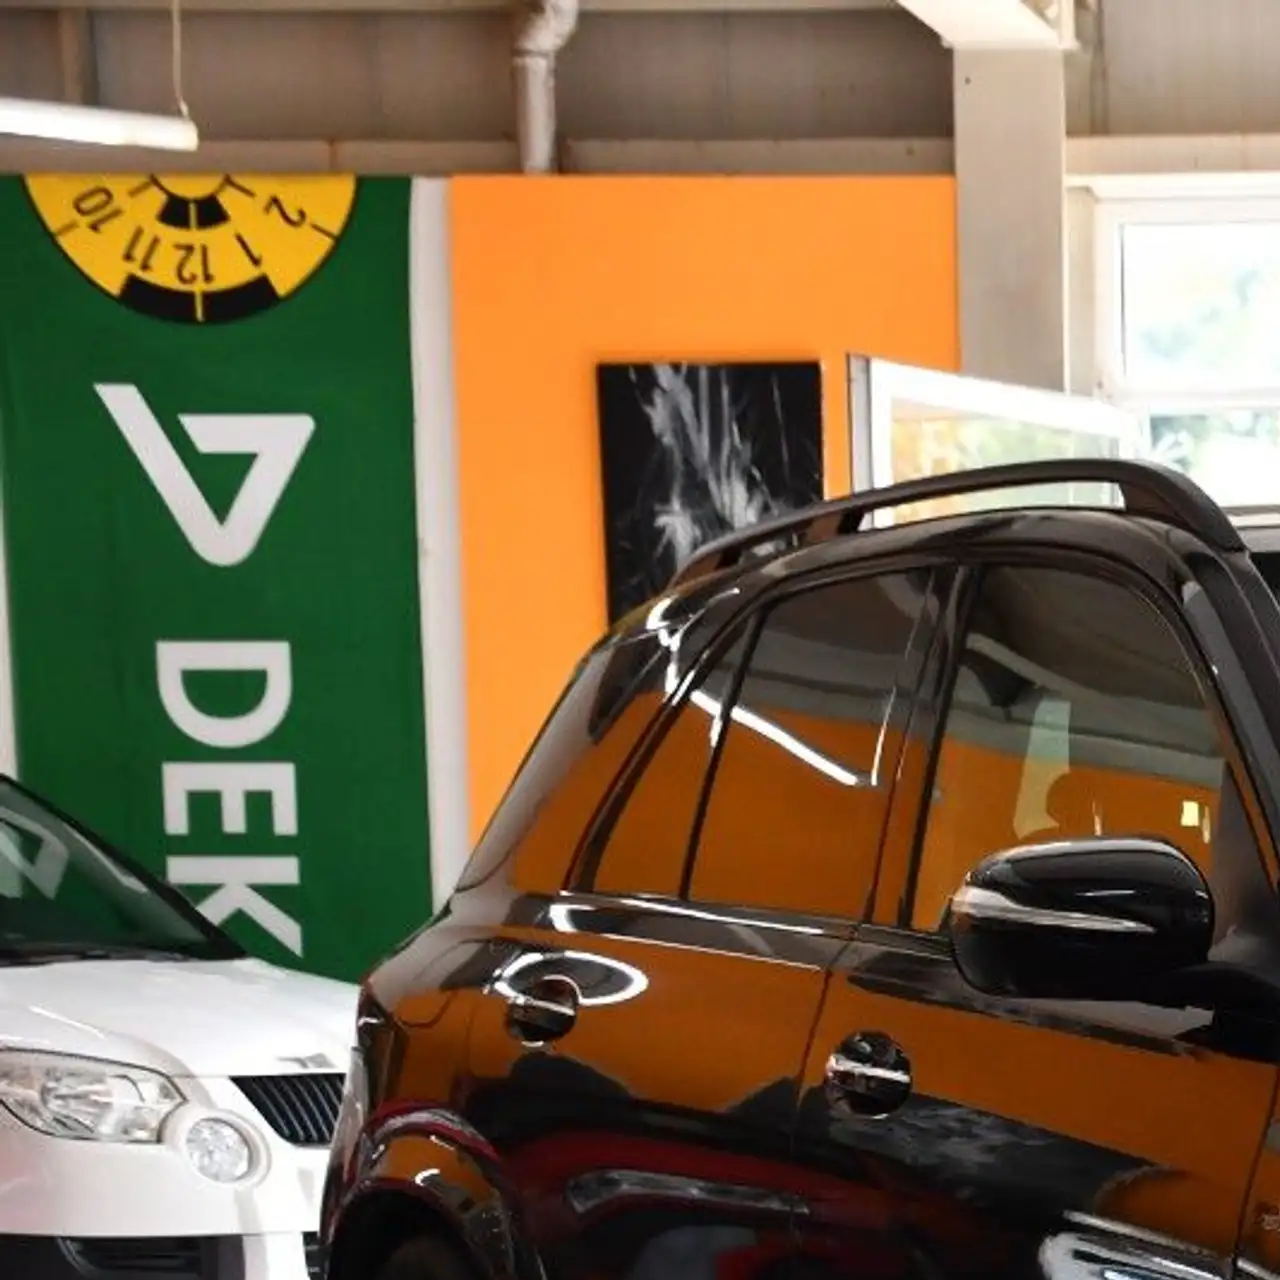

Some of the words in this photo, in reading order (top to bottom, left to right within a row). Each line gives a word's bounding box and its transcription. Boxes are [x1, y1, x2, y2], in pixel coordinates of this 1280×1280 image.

[74, 186, 123, 233] 10
[264, 195, 307, 227] 2
[122, 226, 161, 271] 11
[173, 243, 214, 284] 12
[234, 231, 262, 267] 1
